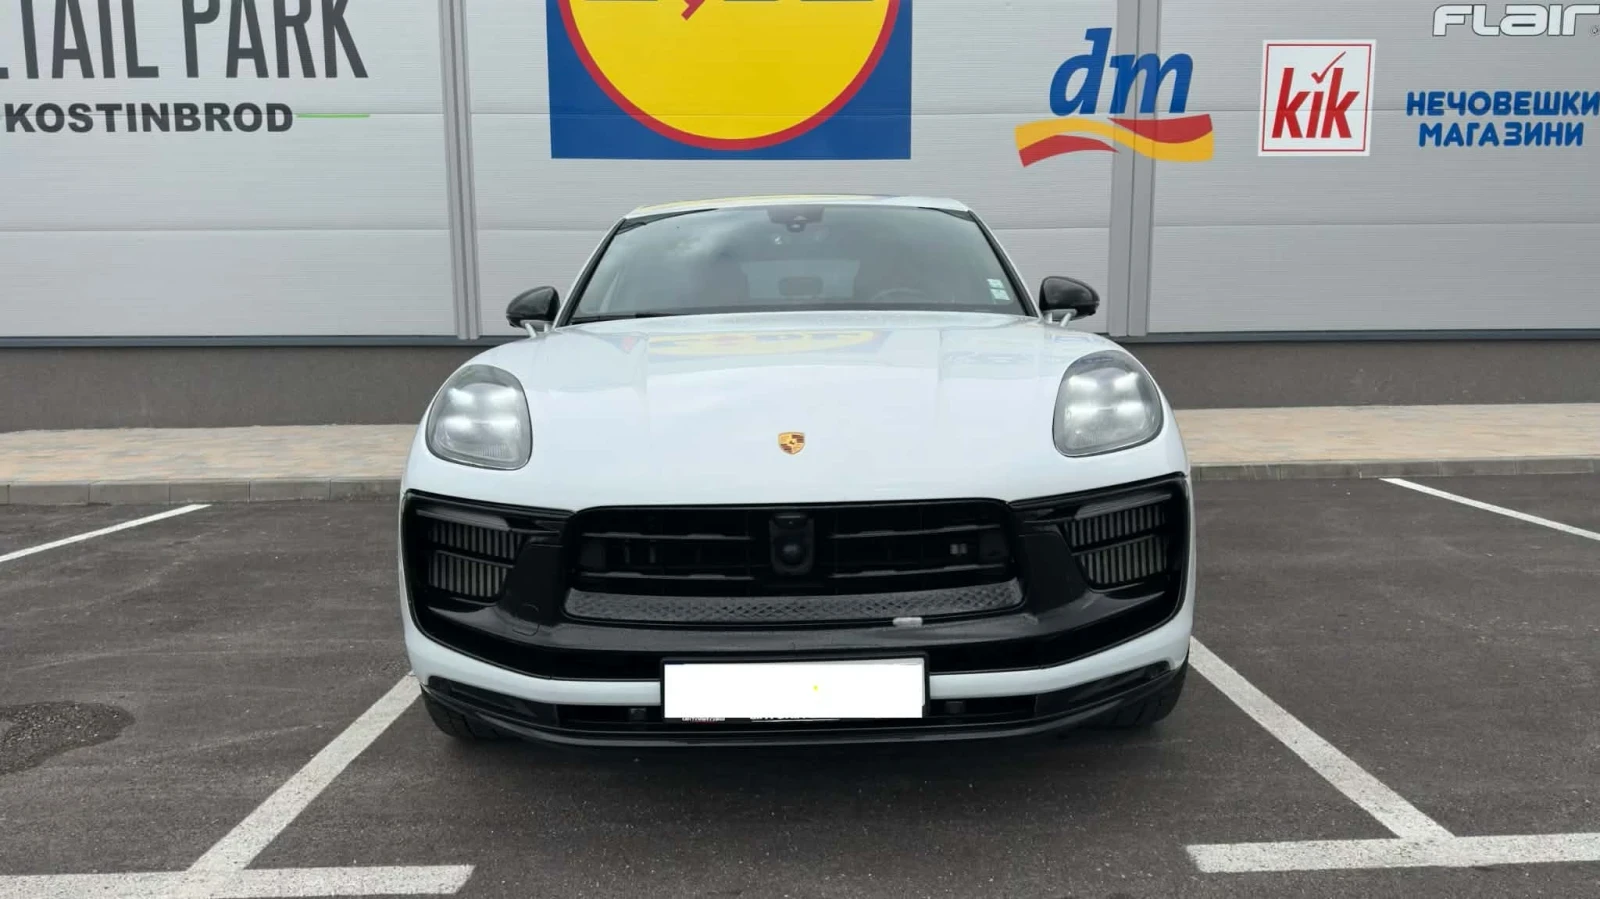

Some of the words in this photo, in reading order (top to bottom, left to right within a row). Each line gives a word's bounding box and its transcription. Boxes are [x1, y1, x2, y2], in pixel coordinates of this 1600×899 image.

[182, 0, 369, 78] PARK
[1050, 27, 1193, 116] dm
[5, 102, 293, 133] KOSTINBROD
[1406, 91, 1600, 116] НЕЧОВЕШКИ
[1418, 121, 1584, 147] МАГАЗИНИ
